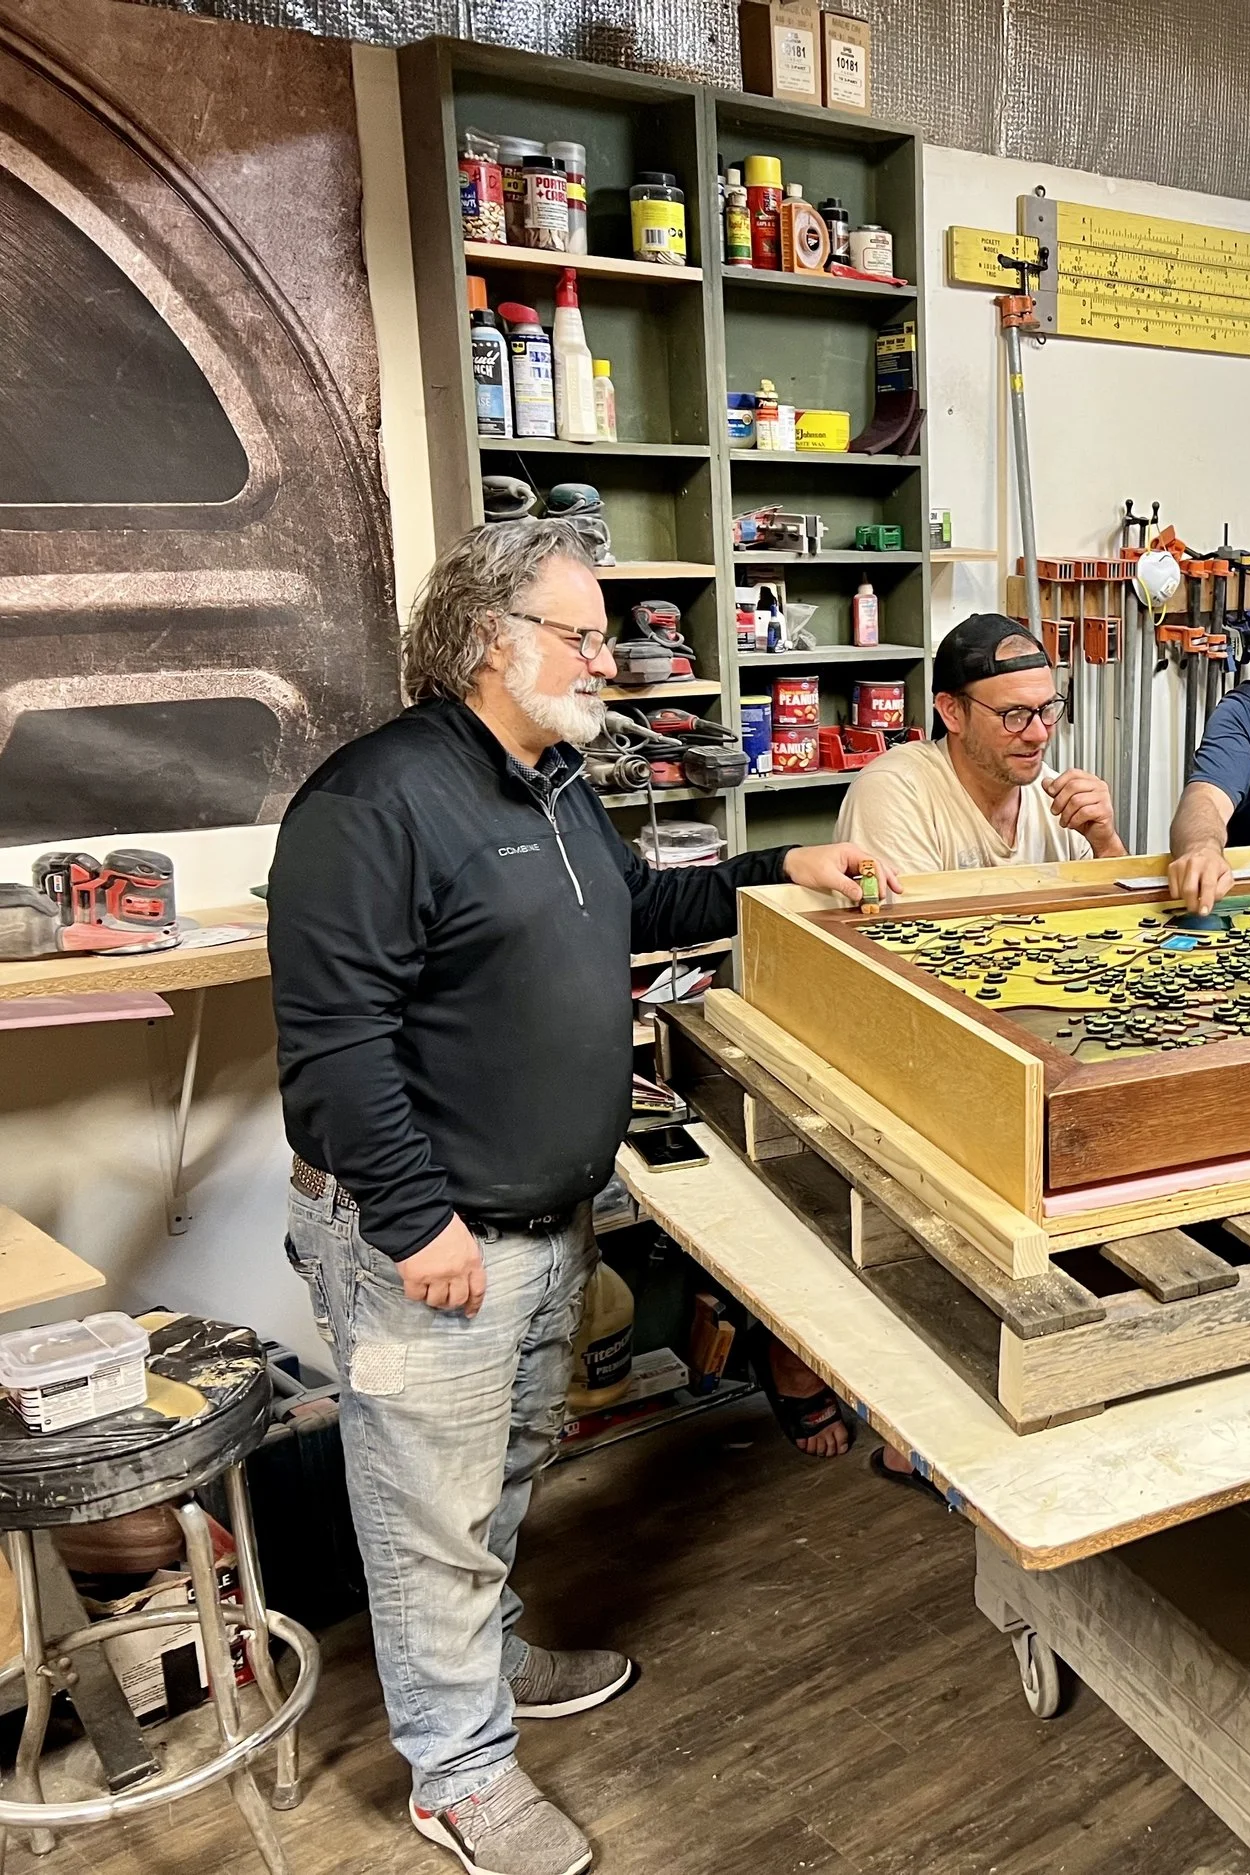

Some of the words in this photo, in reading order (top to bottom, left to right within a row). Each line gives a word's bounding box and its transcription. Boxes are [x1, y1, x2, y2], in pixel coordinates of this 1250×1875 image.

[836, 56, 859, 73] 10181
[536, 176, 567, 190] PORTE
[545, 189, 568, 203] CABL
[981, 238, 1001, 246] PICKETT
[983, 246, 999, 254] MODEL
[1011, 247, 1019, 255] ST
[798, 428, 827, 441] Johnson
[498, 843, 541, 857] COMBINE
